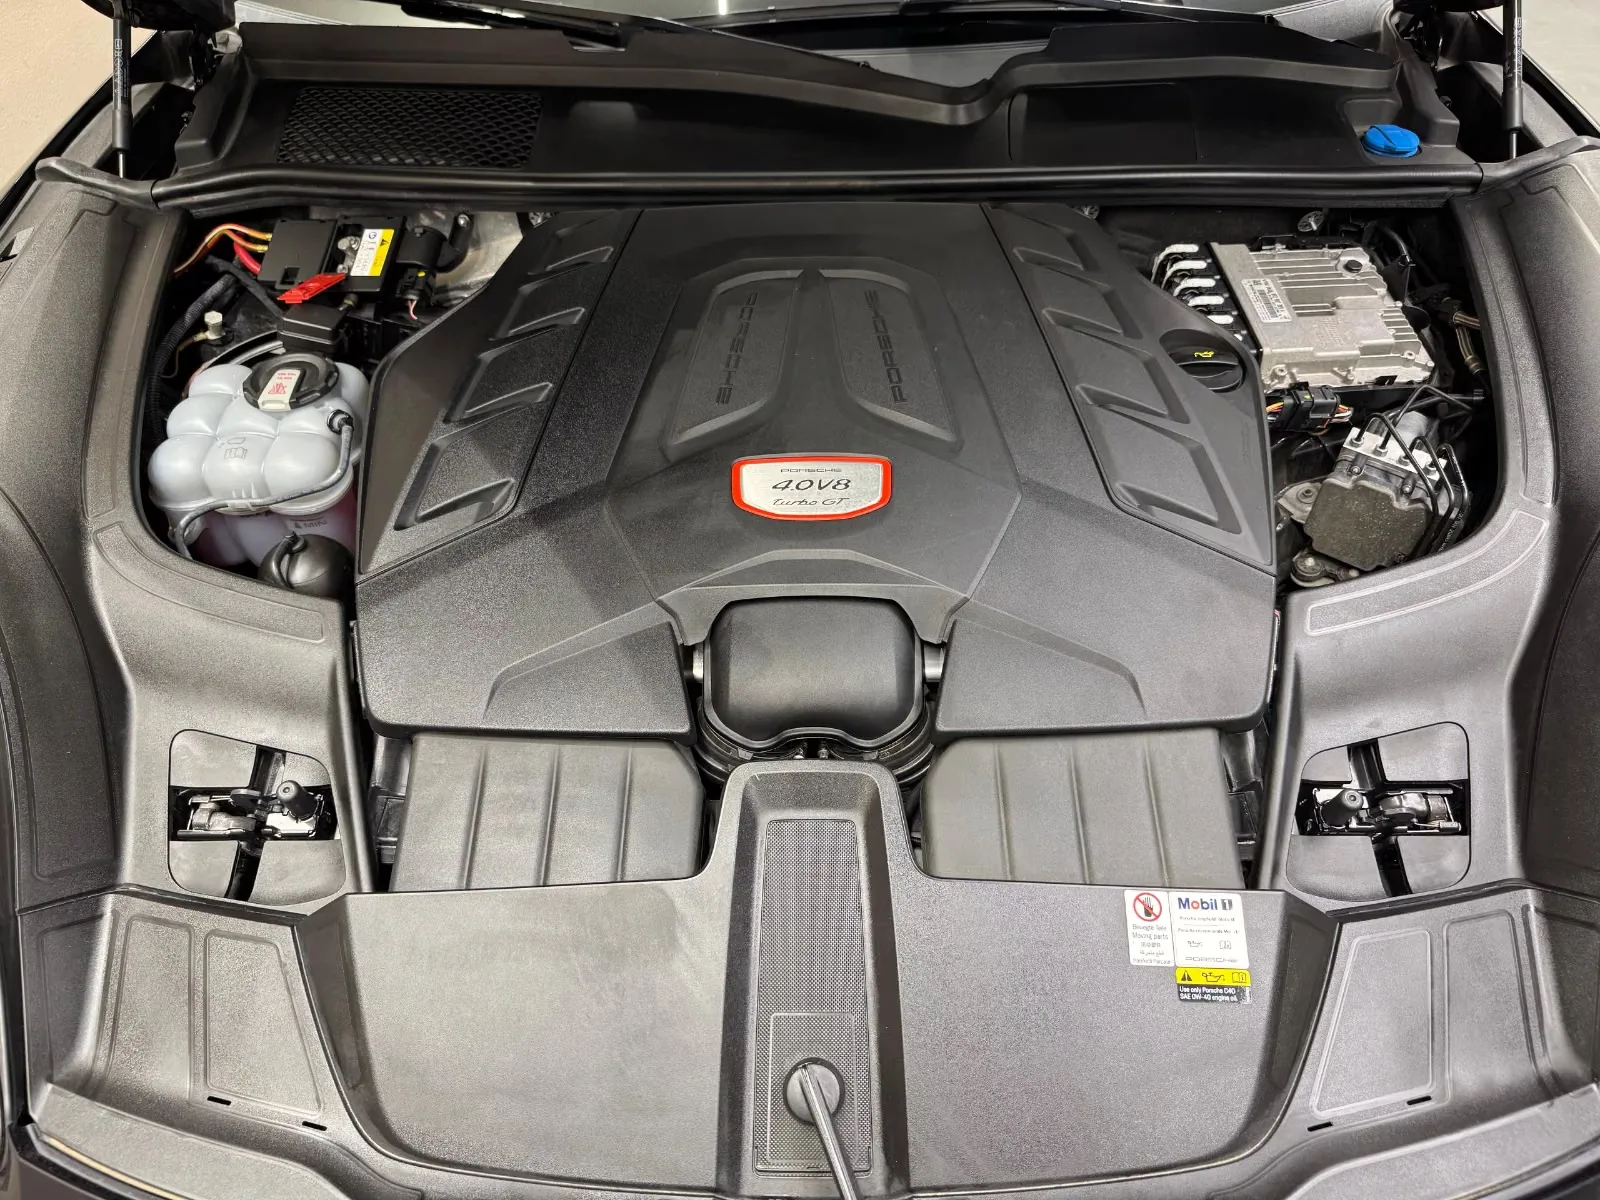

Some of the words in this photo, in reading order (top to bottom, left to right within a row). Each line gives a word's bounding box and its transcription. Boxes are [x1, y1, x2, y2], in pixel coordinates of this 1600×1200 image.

[864, 290, 908, 403] PORSCHE
[821, 497, 850, 506] GT
[1177, 897, 1218, 911] Mobil
[1221, 898, 1233, 911] 1
[1132, 932, 1152, 940] Moving
[1190, 987, 1201, 995] only
[1211, 994, 1230, 1002] engine
